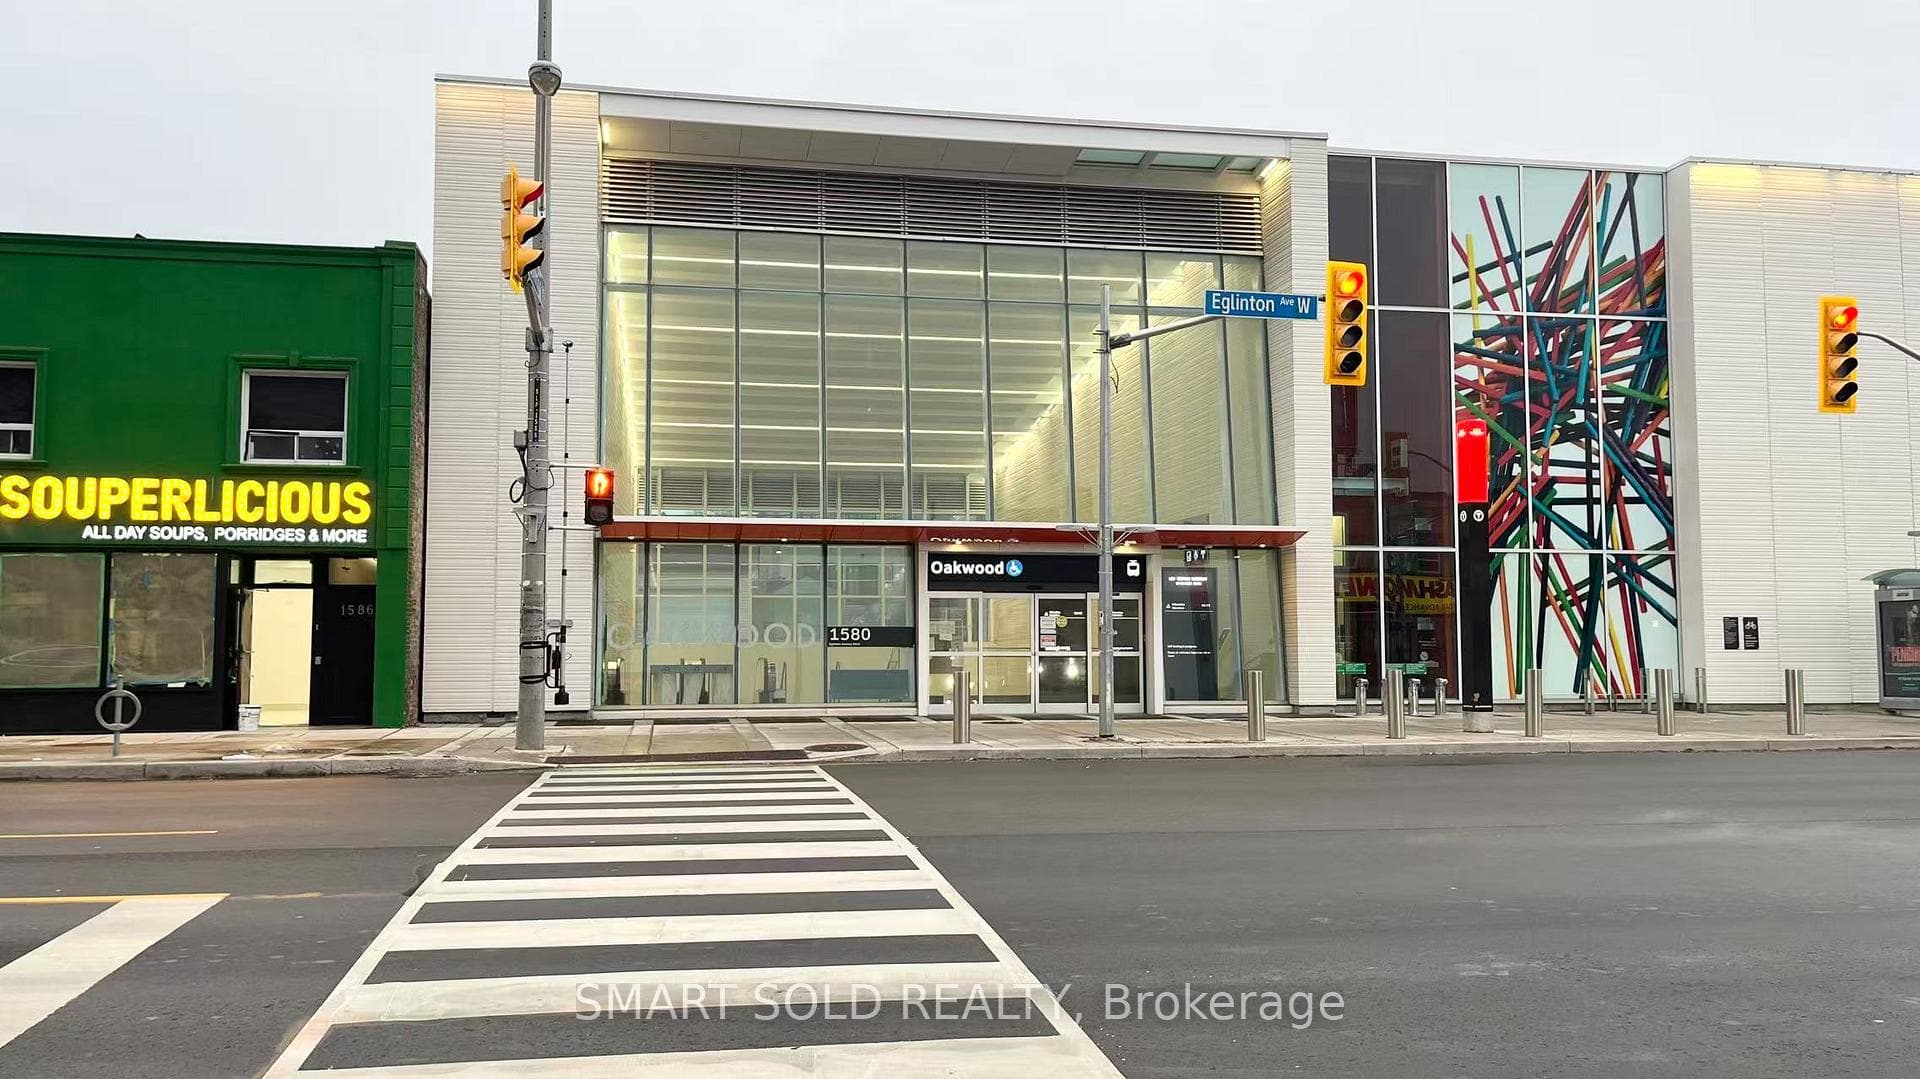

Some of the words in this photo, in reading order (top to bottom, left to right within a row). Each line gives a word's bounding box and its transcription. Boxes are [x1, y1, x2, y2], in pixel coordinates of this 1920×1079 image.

[1212, 293, 1275, 314] Eglinton
[1280, 297, 1294, 306] Ave
[1297, 297, 1310, 314] W
[0, 474, 372, 524] SOUPERLICIOUS
[82, 525, 112, 539] ALL
[114, 525, 147, 540] DAY
[149, 525, 208, 542] SOUPS,
[214, 527, 305, 542] PORRIDGES
[308, 528, 319, 542] &
[322, 529, 368, 543] MORE
[930, 560, 1004, 575] Oakwood
[340, 604, 374, 616] 1586
[830, 628, 871, 641] 1580
